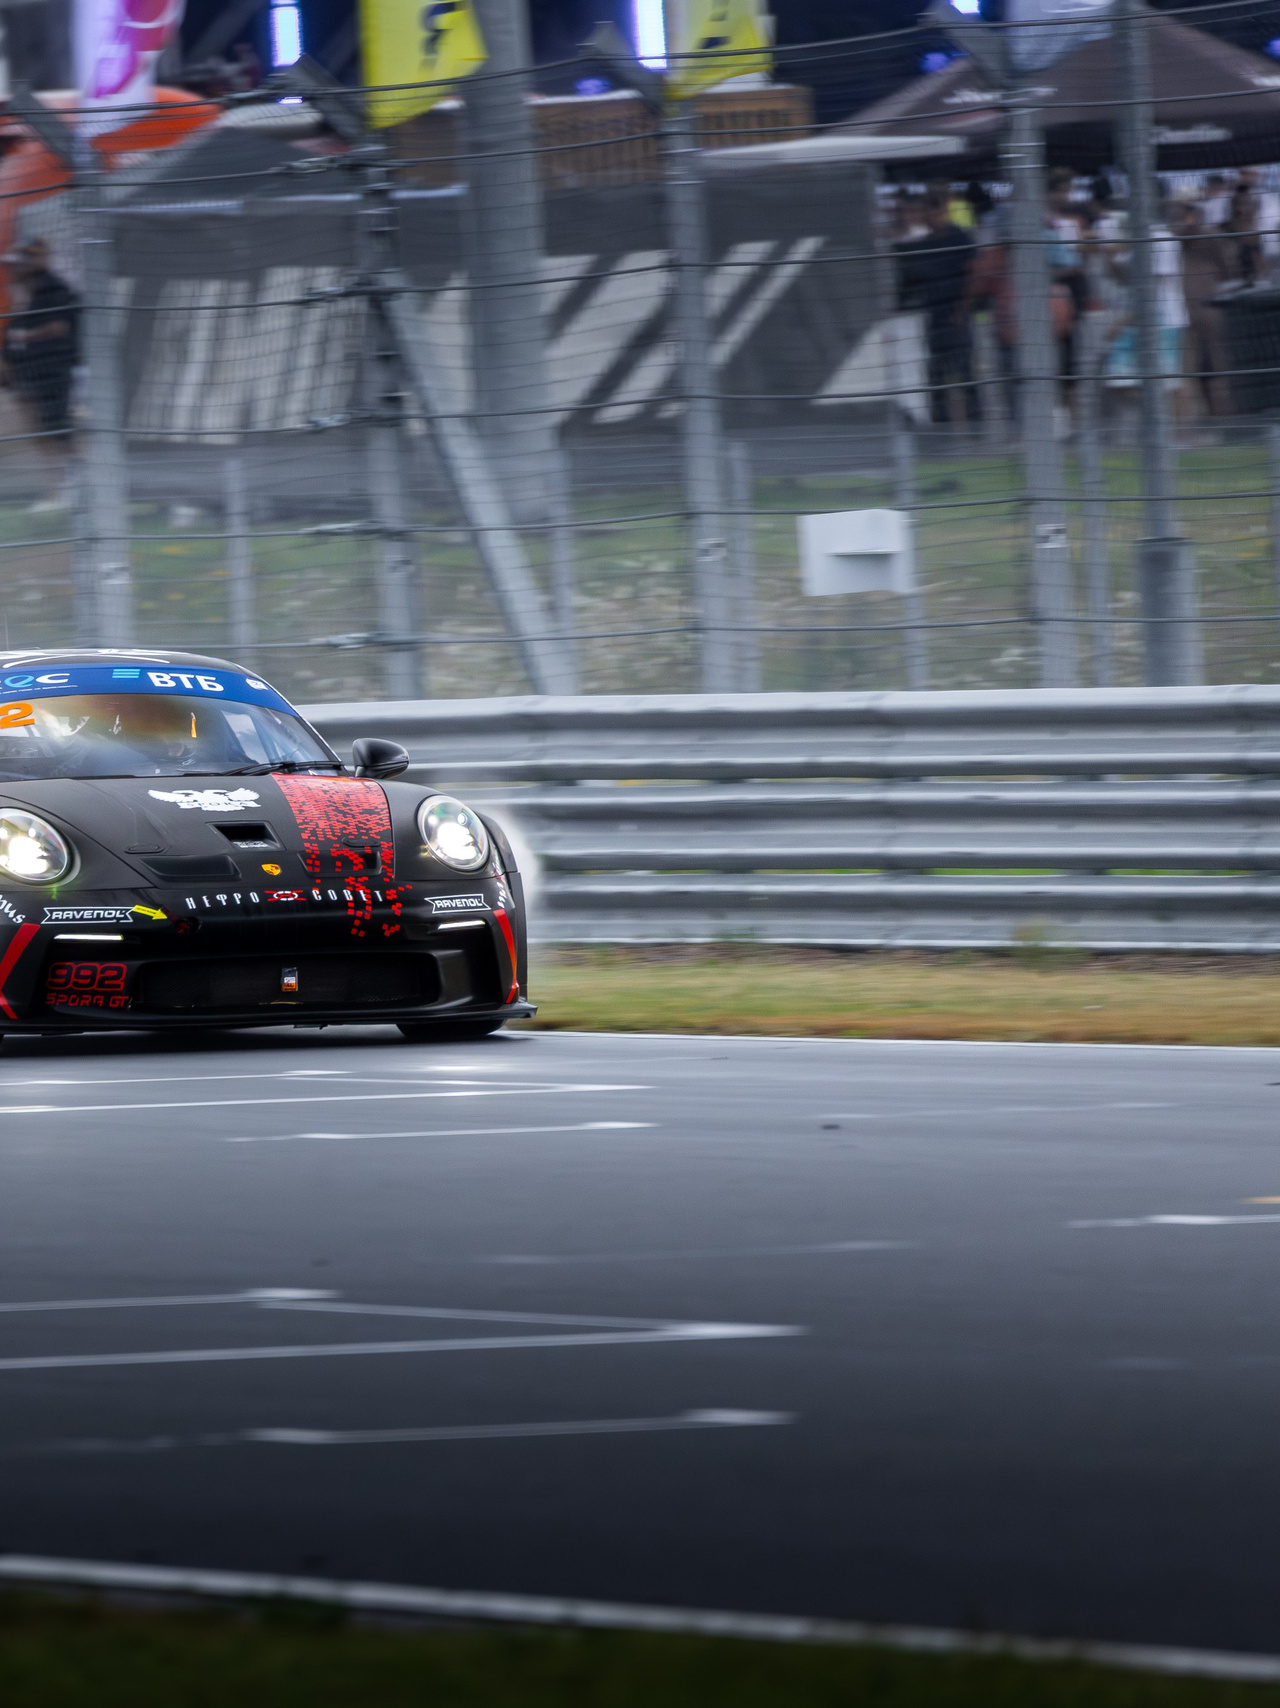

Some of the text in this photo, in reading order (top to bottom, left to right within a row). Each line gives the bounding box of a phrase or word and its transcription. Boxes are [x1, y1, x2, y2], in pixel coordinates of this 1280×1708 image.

[147, 672, 224, 692] ВТБ
[185, 891, 260, 910] НЕФРО
[434, 898, 483, 908] RAVENOL
[52, 910, 126, 920] RAVENOL
[47, 962, 128, 991] 992
[45, 993, 130, 1008] SPORA GT
